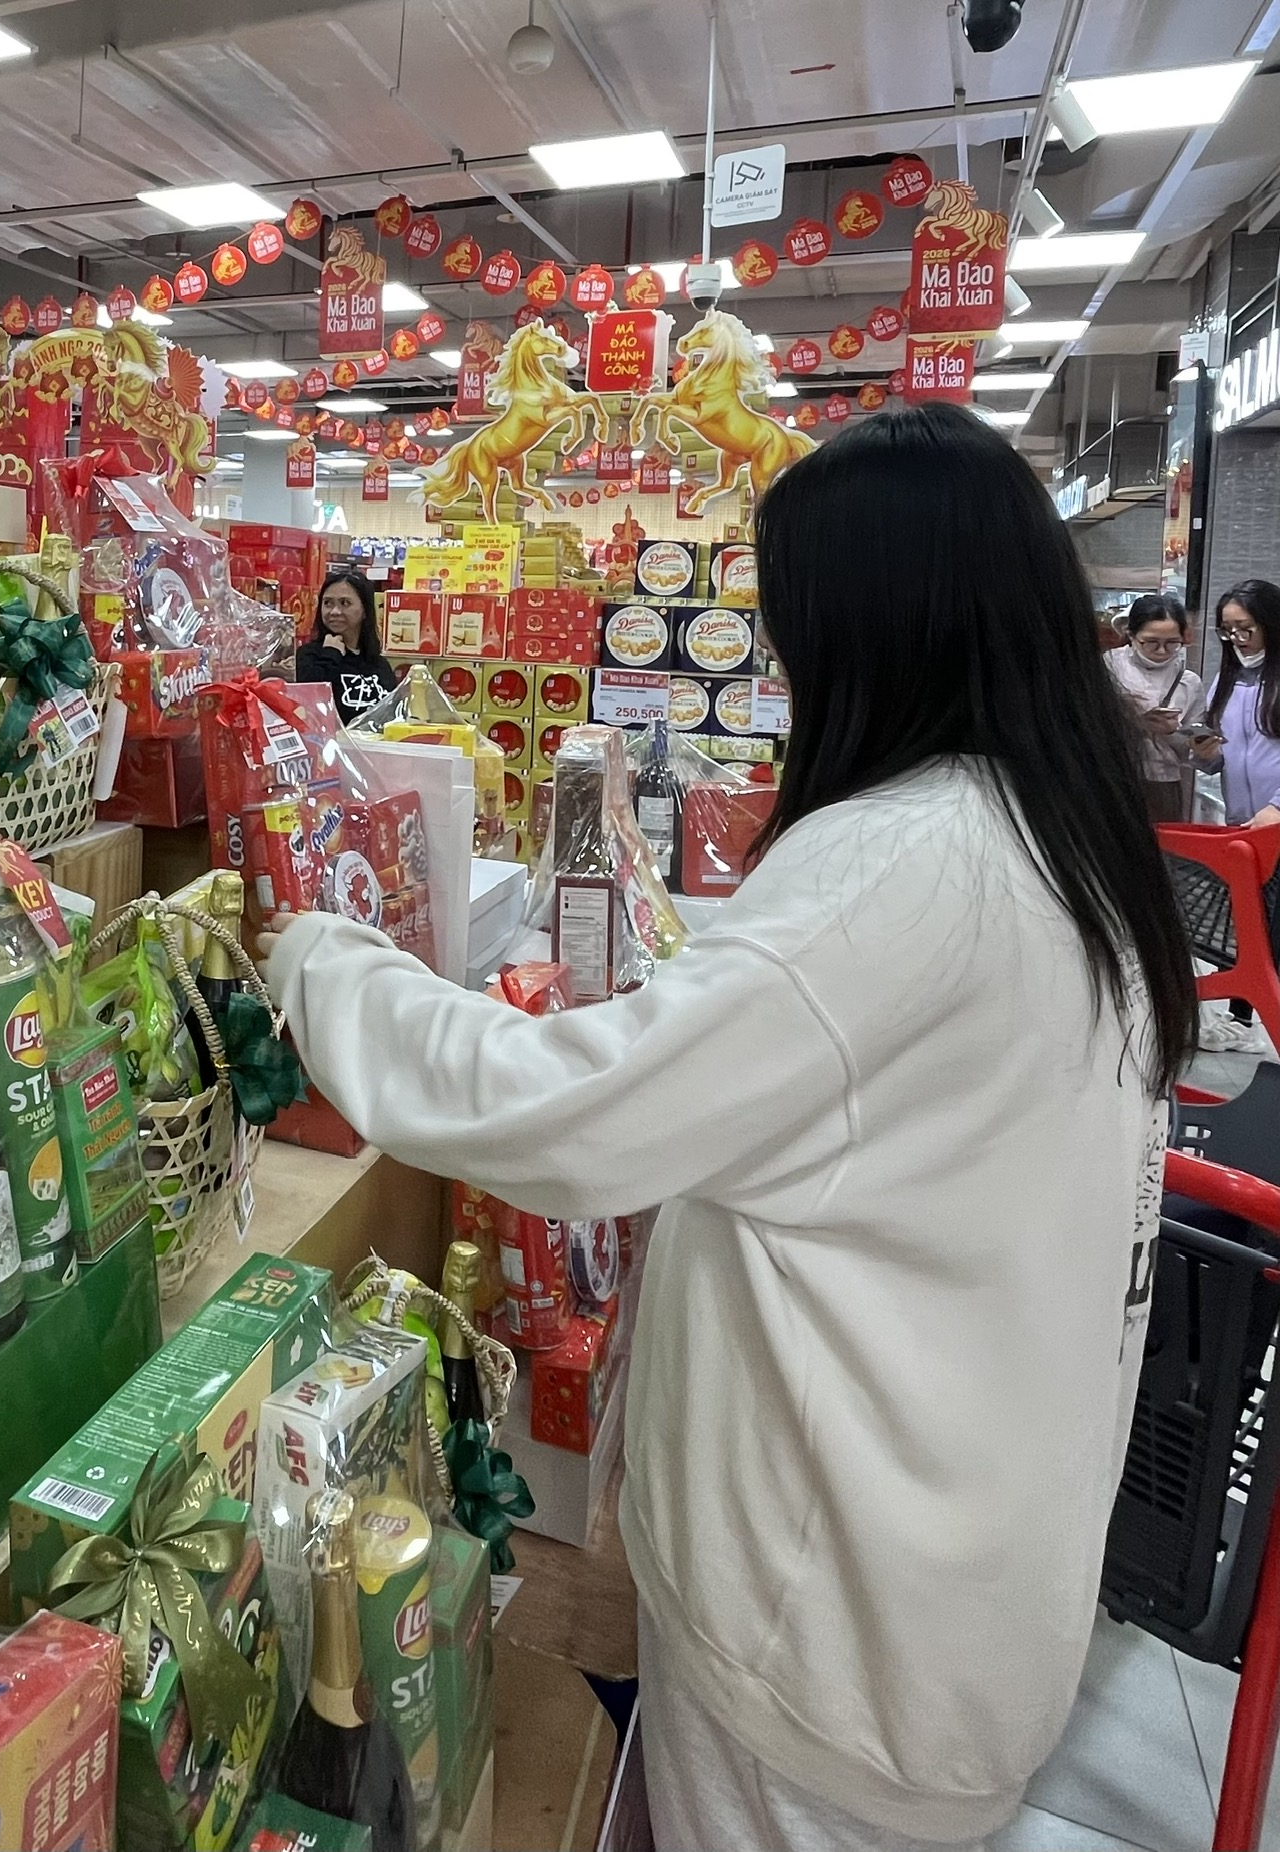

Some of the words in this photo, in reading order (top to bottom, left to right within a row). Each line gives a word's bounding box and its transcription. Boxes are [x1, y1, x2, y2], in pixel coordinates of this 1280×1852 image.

[715, 192, 744, 204] CAMERA
[736, 201, 754, 209] CCTV
[923, 249, 950, 259] 2026
[922, 264, 950, 289] Mã
[957, 261, 994, 287] Đáo
[921, 287, 951, 309] Khai
[956, 286, 993, 306] Xuân
[614, 321, 635, 335] MÃ
[610, 335, 638, 348] ĐÁO
[601, 347, 646, 361] THÀNH
[605, 362, 639, 376] CÔNG
[647, 551, 682, 566] Danisa
[473, 564, 497, 572] 599K
[390, 596, 400, 608] LU
[452, 598, 463, 610] LU
[616, 617, 656, 632] Danisa
[696, 620, 739, 636] Danisa
[615, 706, 664, 720] 250,500
[227, 813, 245, 867] COSY
[13, 879, 49, 910] KEY
[30, 906, 54, 923] ODUCT
[12, 1009, 43, 1052] Lay
[7, 1069, 52, 1113] STA
[18, 1108, 45, 1126] SOUR
[243, 1275, 298, 1296] KEN
[257, 1294, 287, 1310] JU
[294, 1381, 322, 1406] AFC
[282, 1422, 309, 1487] AFC
[363, 1512, 410, 1536] Lay's
